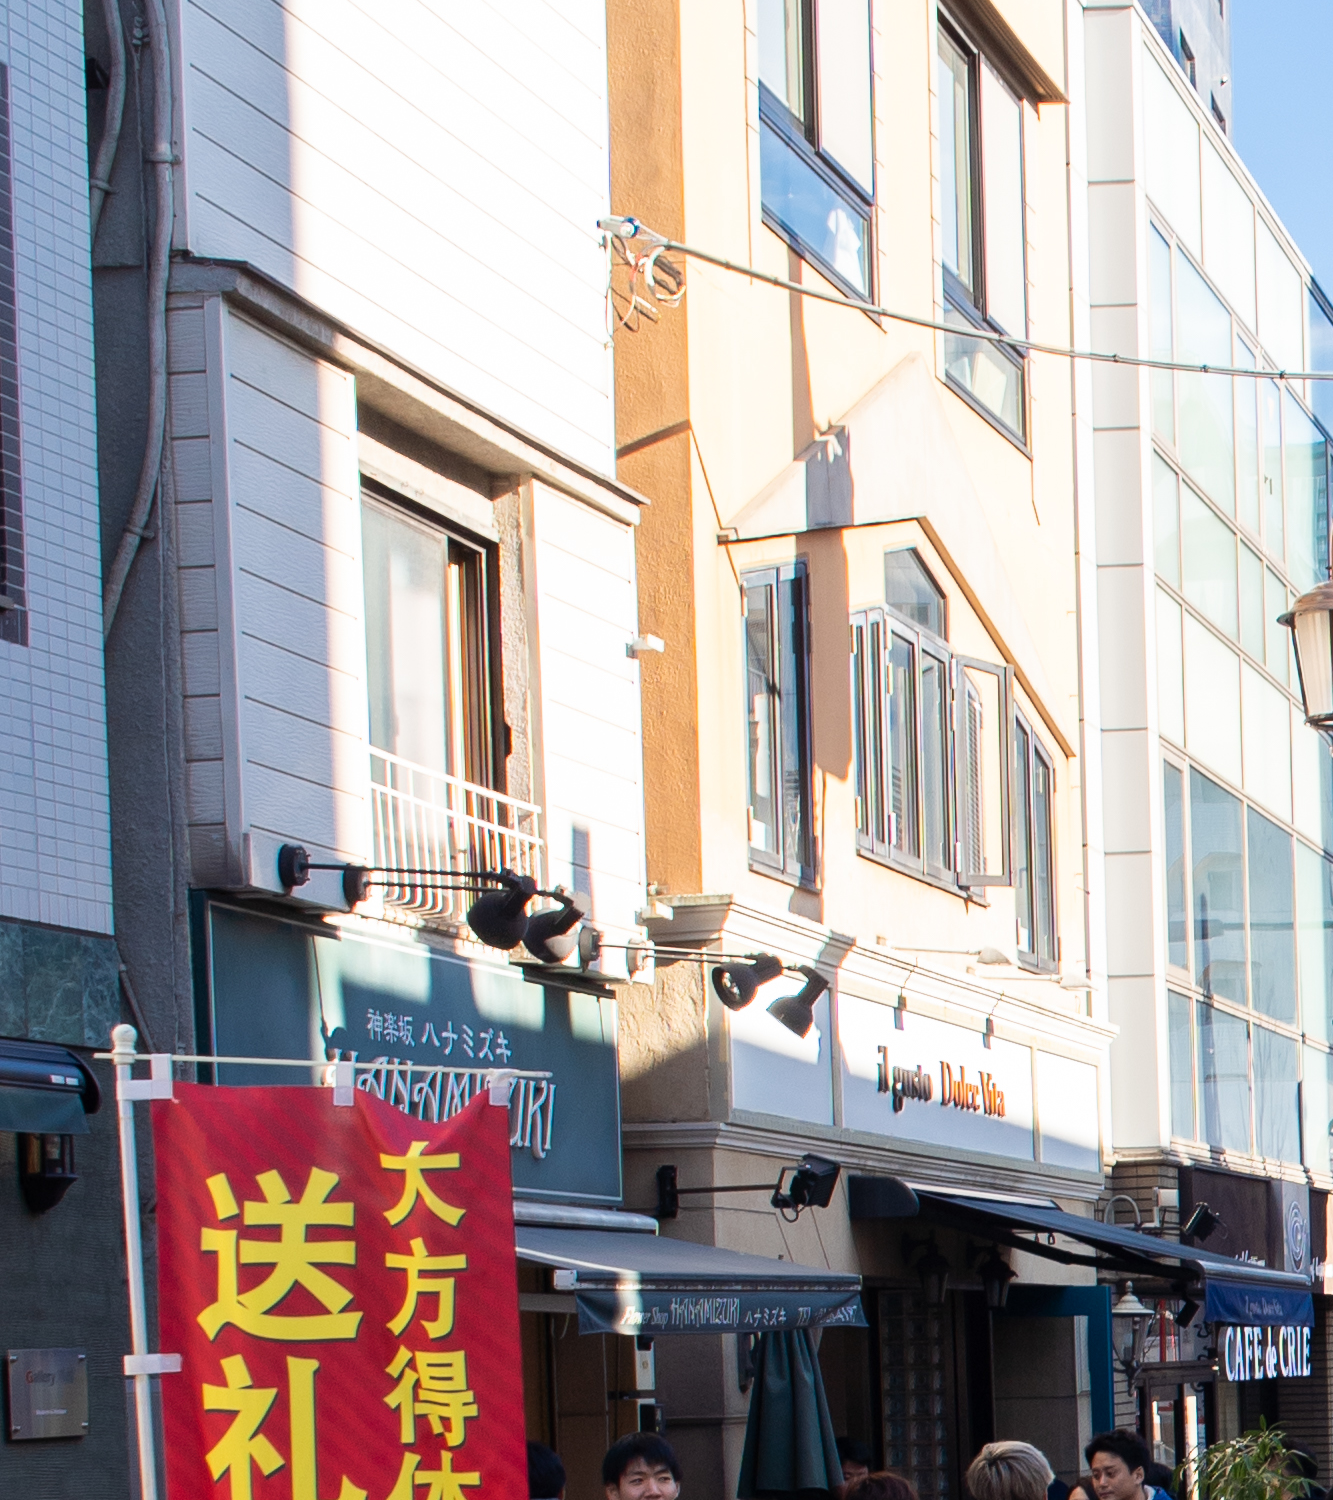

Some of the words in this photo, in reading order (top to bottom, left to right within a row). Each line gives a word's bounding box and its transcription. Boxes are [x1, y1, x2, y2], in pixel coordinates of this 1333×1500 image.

[367, 1008, 416, 1048] 神楽坂
[420, 1019, 512, 1064] ハナミズキ
[939, 1060, 981, 1112] Dolce
[978, 1070, 1006, 1118] Vita
[1265, 1324, 1278, 1379] de
